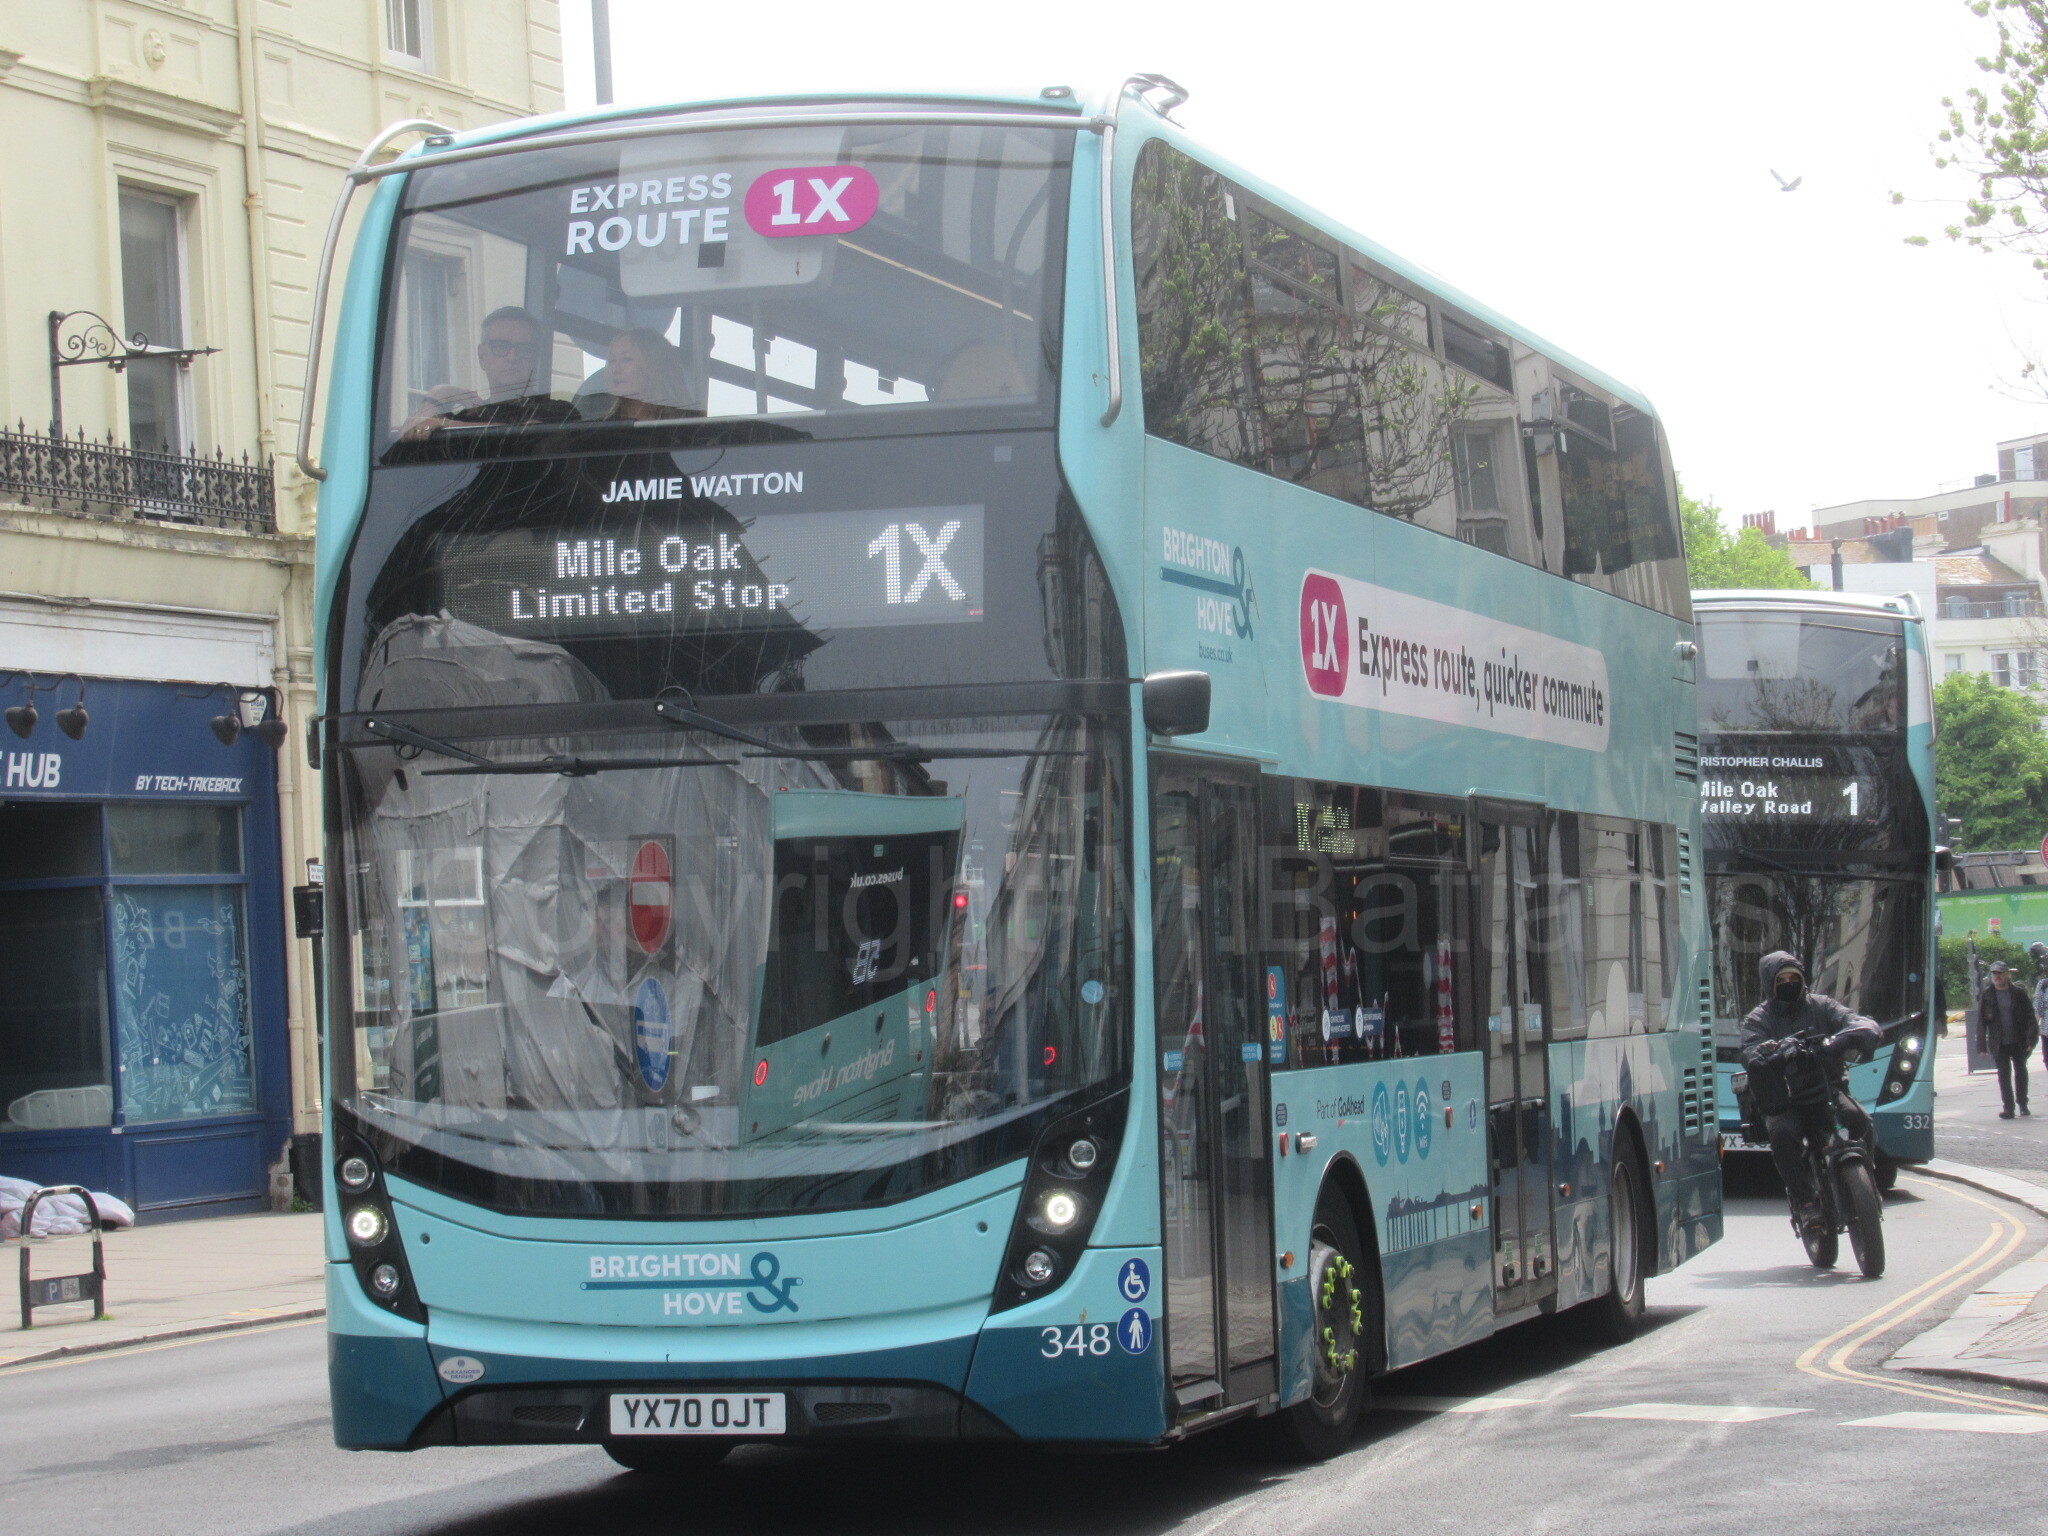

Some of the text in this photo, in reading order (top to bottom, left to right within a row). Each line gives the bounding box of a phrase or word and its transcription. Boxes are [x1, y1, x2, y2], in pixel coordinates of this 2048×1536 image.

[570, 172, 733, 214] EXPRESS
[771, 176, 854, 226] 1X
[566, 206, 730, 256] ROUTE
[602, 471, 804, 503] JAMIE WATTON
[557, 533, 742, 578] Mile Oak
[868, 520, 966, 604] 1X
[1163, 526, 1231, 577] BRIGHTON
[512, 579, 790, 619] Limited Stop
[1197, 595, 1233, 636] HOVE
[1198, 640, 1234, 664] buses.co.uk
[1310, 598, 1340, 673] 1X
[1358, 616, 1604, 727] Express route, quicker commute
[6, 752, 62, 788] HUB
[1700, 757, 1824, 768] RISTOPHER CHALLIS
[135, 775, 244, 793] BY TECH-TAKEBACK
[1740, 781, 1779, 798] Oak
[1842, 782, 1858, 816] 1
[1765, 801, 1812, 815] Road
[1316, 1099, 1329, 1119] Part
[1329, 1097, 1337, 1118] of
[1903, 1115, 1930, 1130] 332
[590, 1253, 741, 1278] BRIGHTON
[49, 1282, 58, 1300] P
[663, 1291, 743, 1316] HOVE
[1041, 1323, 1111, 1358] 348
[624, 1397, 771, 1428] YX70 OJT
